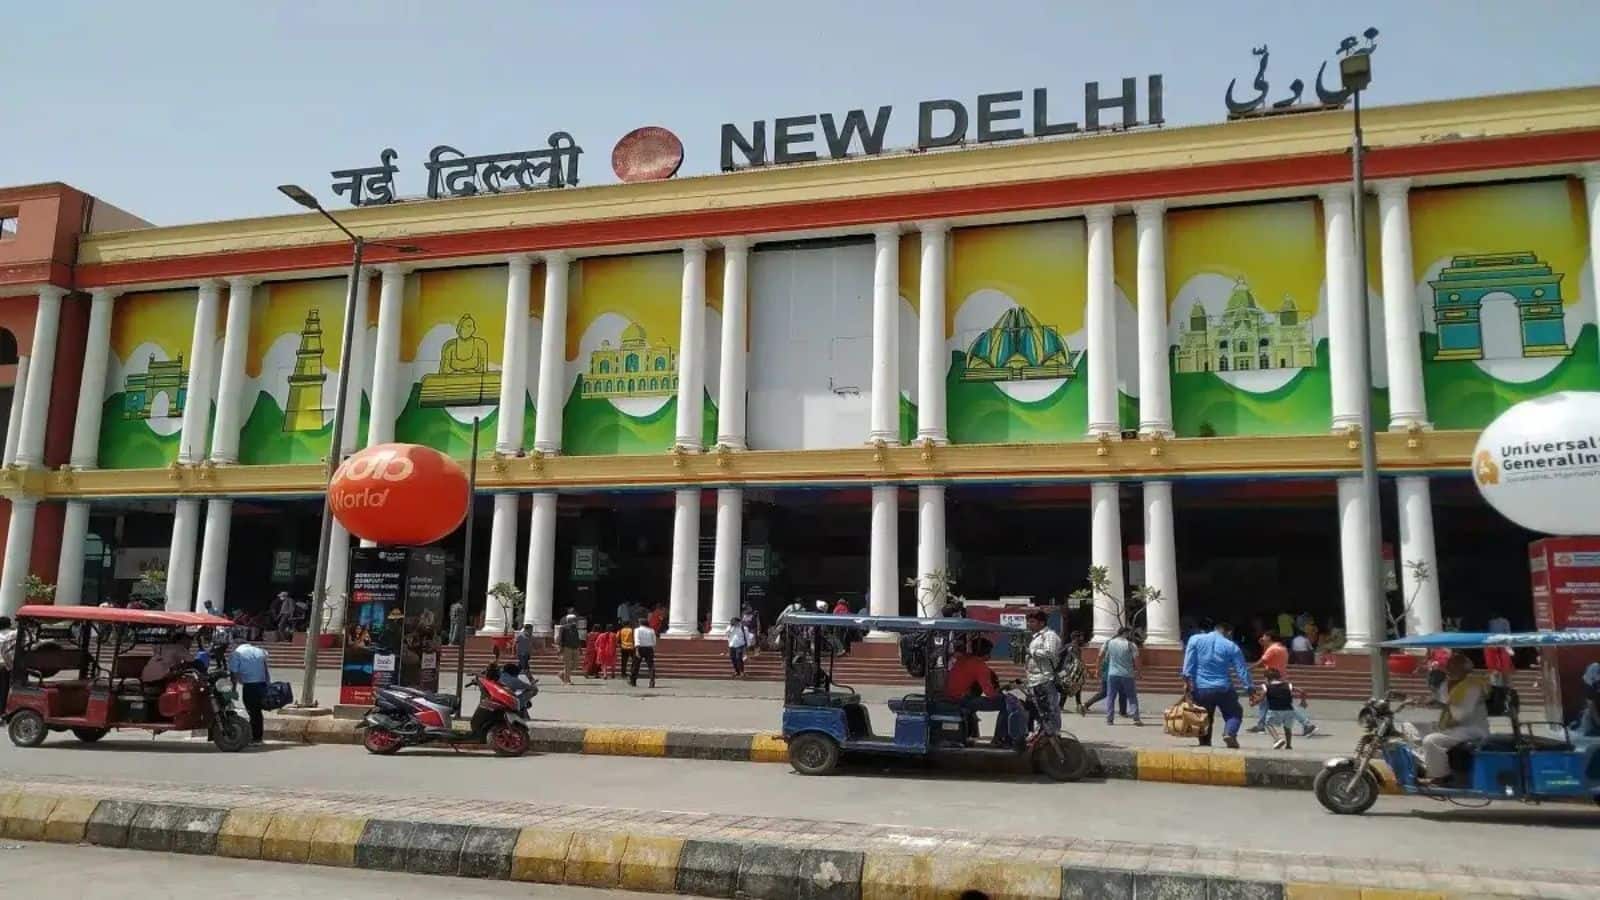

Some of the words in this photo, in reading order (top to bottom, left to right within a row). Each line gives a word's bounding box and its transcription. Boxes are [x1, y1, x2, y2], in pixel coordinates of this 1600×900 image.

[720, 105, 893, 171] NEW
[917, 74, 1164, 150] DELHI
[331, 148, 399, 206] नई
[424, 131, 584, 200] दिल्ली
[1502, 436, 1597, 457] Universal
[1503, 452, 1574, 471] General
